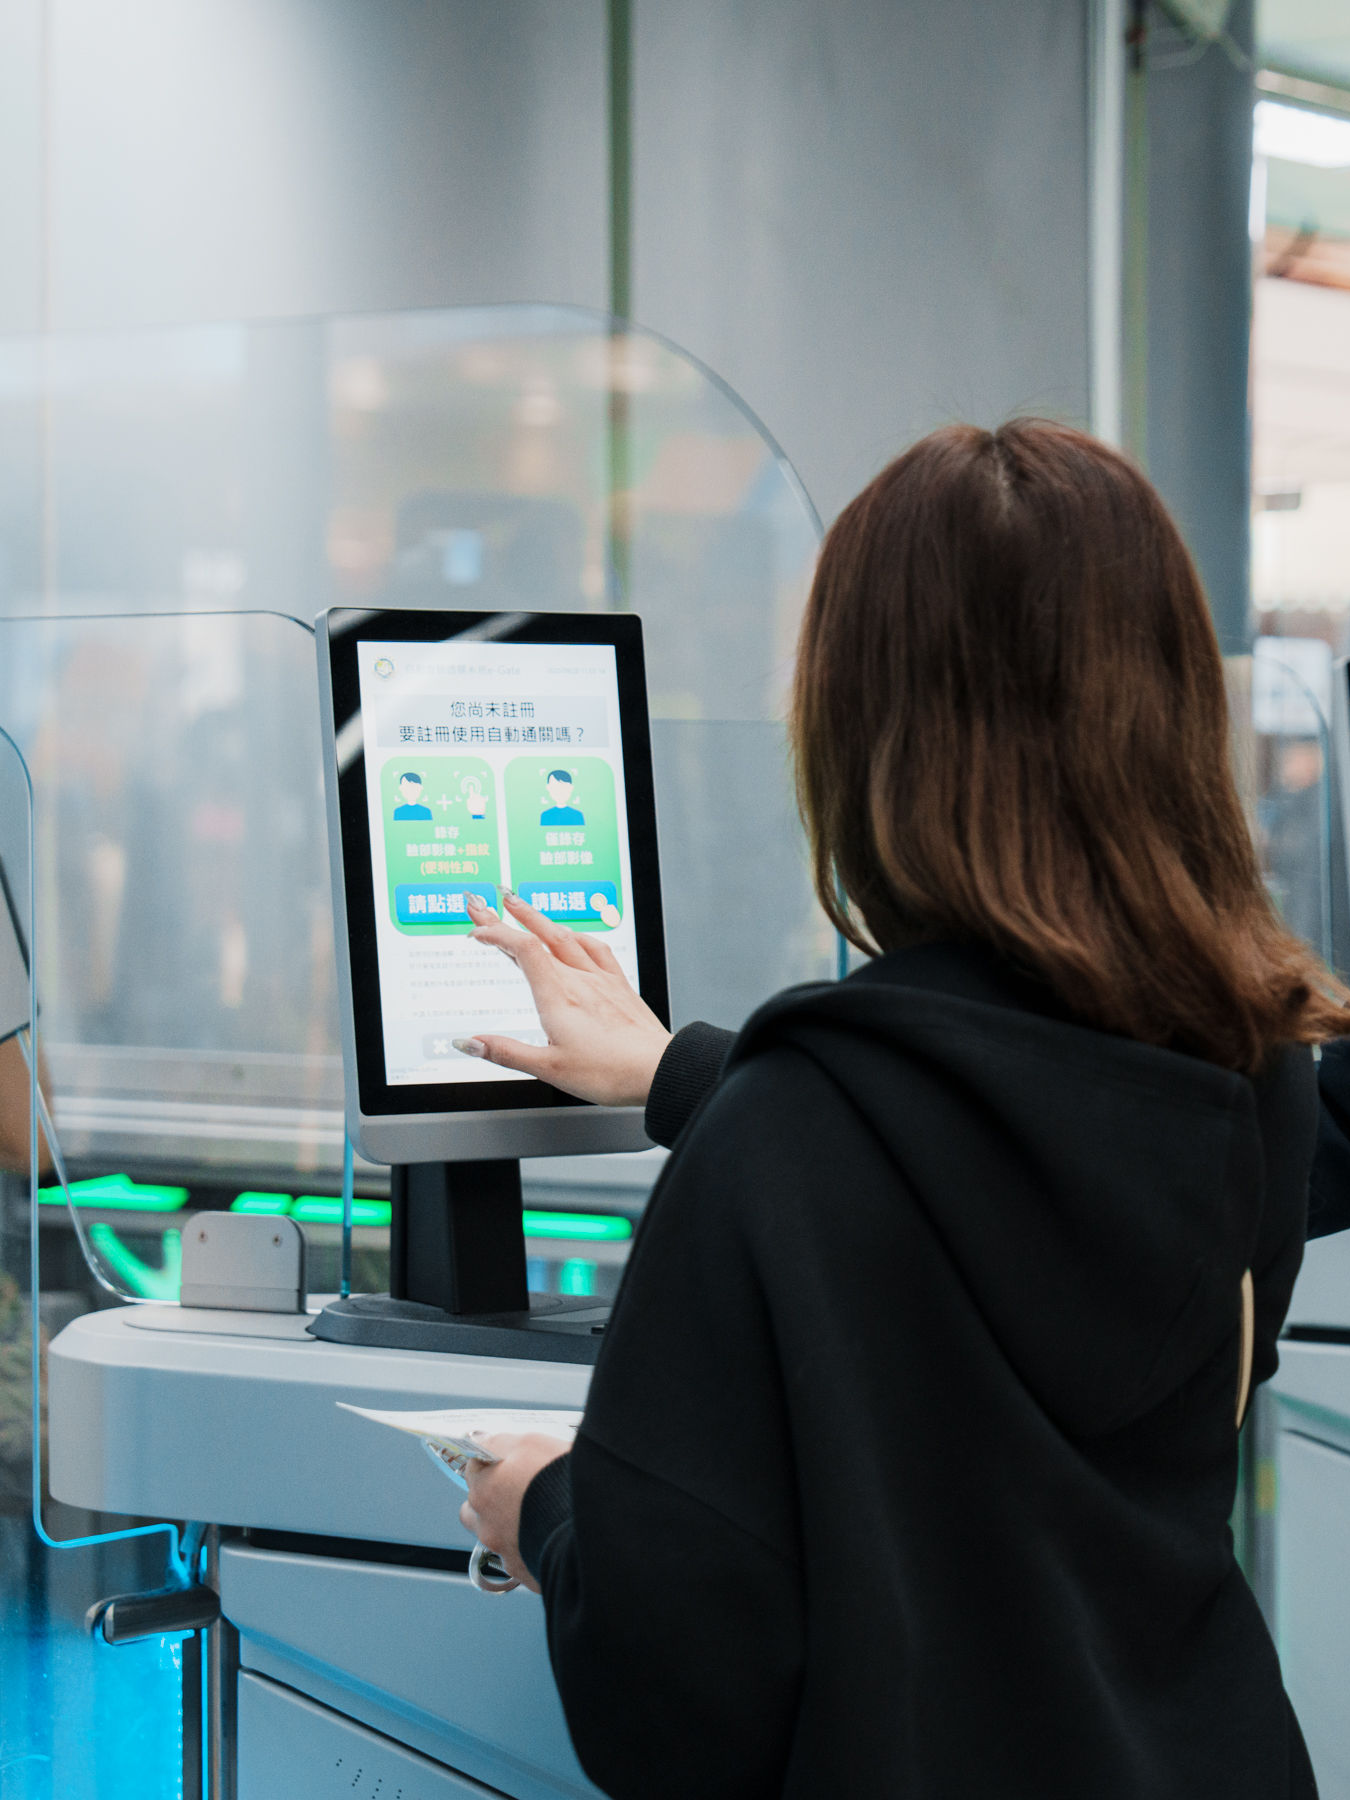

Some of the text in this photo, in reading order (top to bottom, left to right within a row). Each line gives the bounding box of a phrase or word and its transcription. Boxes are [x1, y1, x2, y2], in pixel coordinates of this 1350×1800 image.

[450, 701, 536, 718] 您尚未註冊
[539, 850, 594, 866] 臉部影像
[408, 893, 466, 914] 請點選
[531, 891, 587, 911] 請點選
